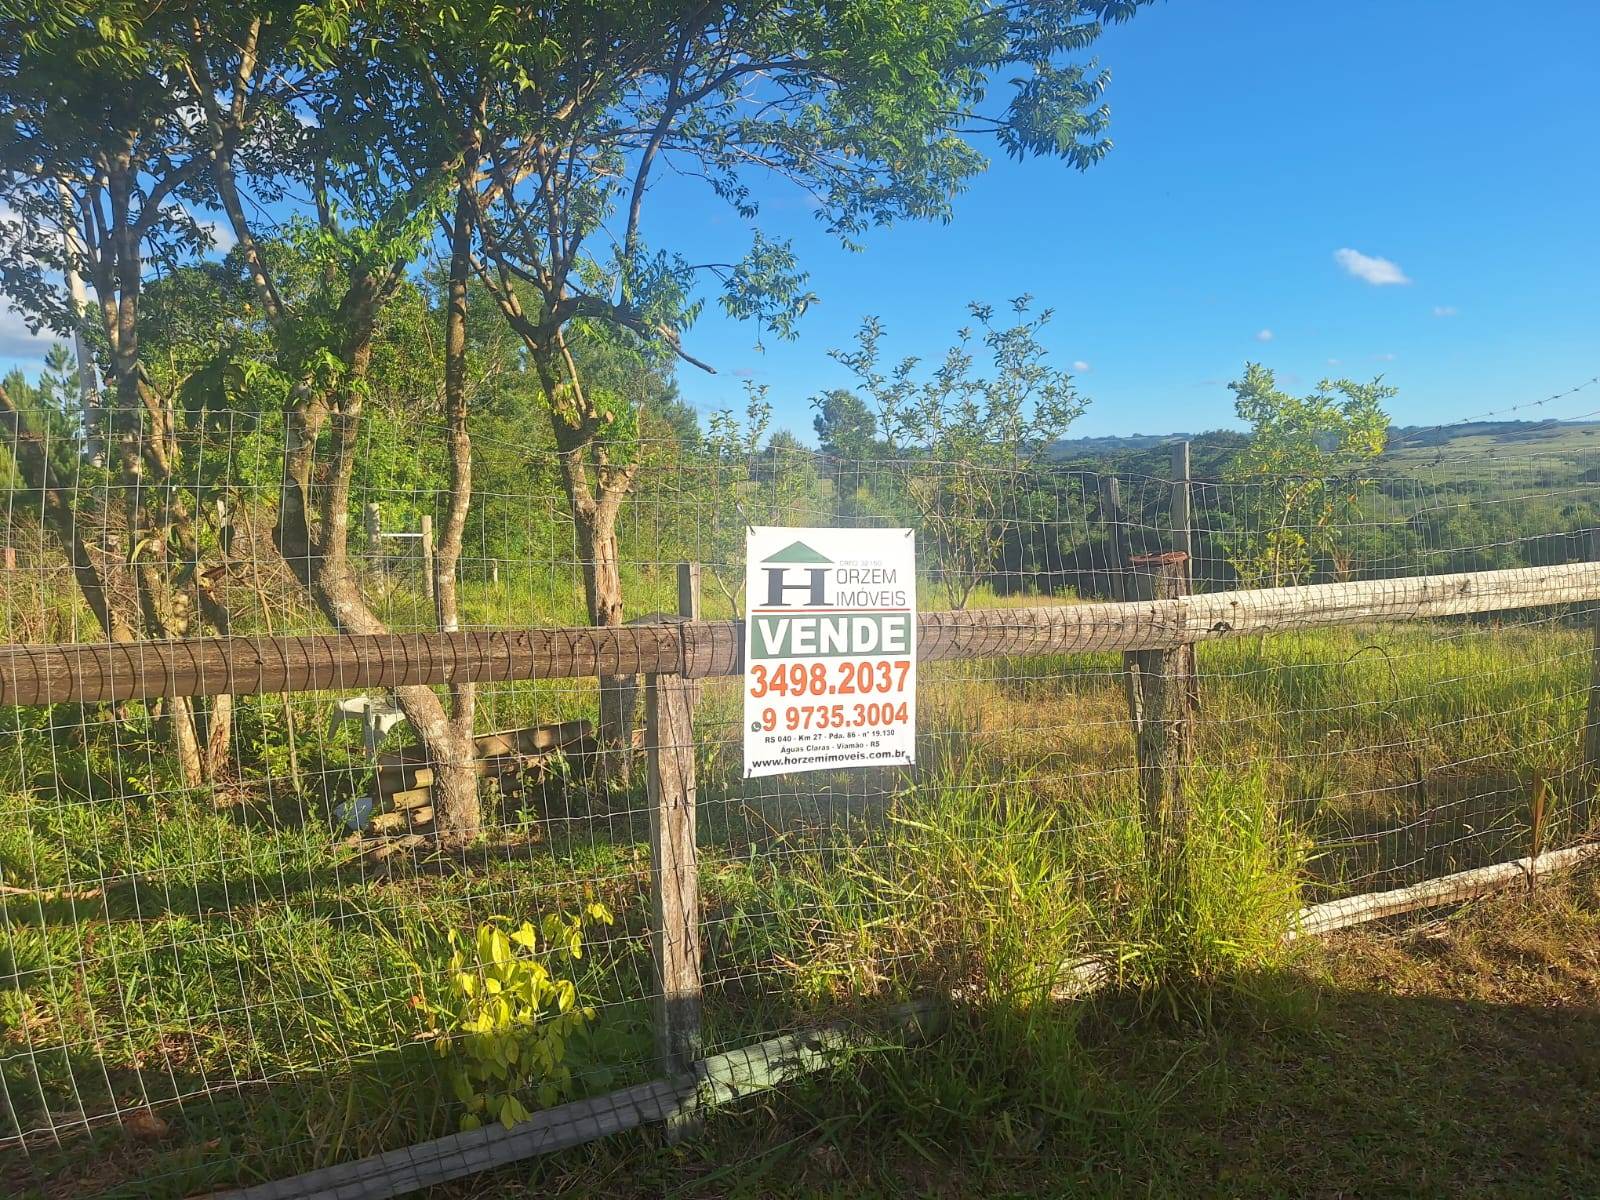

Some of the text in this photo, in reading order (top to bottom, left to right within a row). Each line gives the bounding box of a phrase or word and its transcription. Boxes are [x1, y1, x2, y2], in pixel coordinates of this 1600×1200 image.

[836, 568, 897, 584] ORZEM
[837, 588, 906, 607] IMÓVEIS
[758, 616, 905, 655] VENDE
[750, 660, 911, 698] 3498.2037
[762, 701, 909, 732] 9 9735.3004
[777, 735, 792, 743] 040
[798, 733, 811, 742] Km
[813, 733, 823, 741] 27
[806, 743, 830, 752] Claras
[836, 742, 864, 751] Viamão
[752, 749, 906, 768] www.horzemimoveis.com.br
